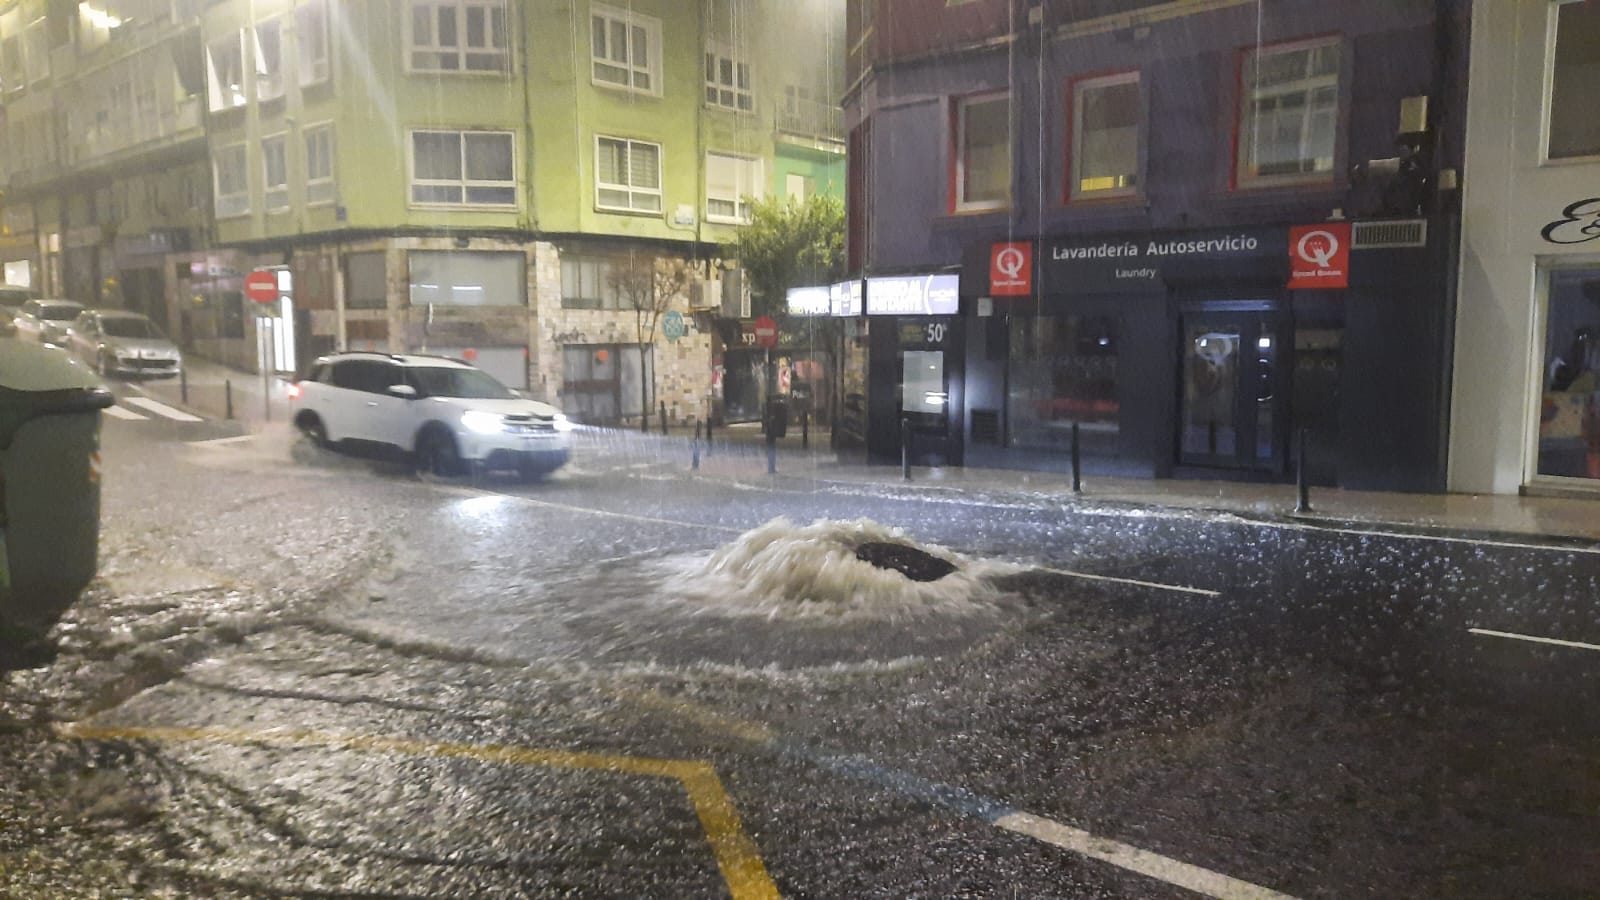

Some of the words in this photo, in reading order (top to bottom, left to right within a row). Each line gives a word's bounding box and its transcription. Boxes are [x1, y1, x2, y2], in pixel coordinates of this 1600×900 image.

[1053, 241, 1138, 260] Lavandería
[1146, 234, 1258, 256] Autoservicio
[1115, 268, 1156, 279] Laundry
